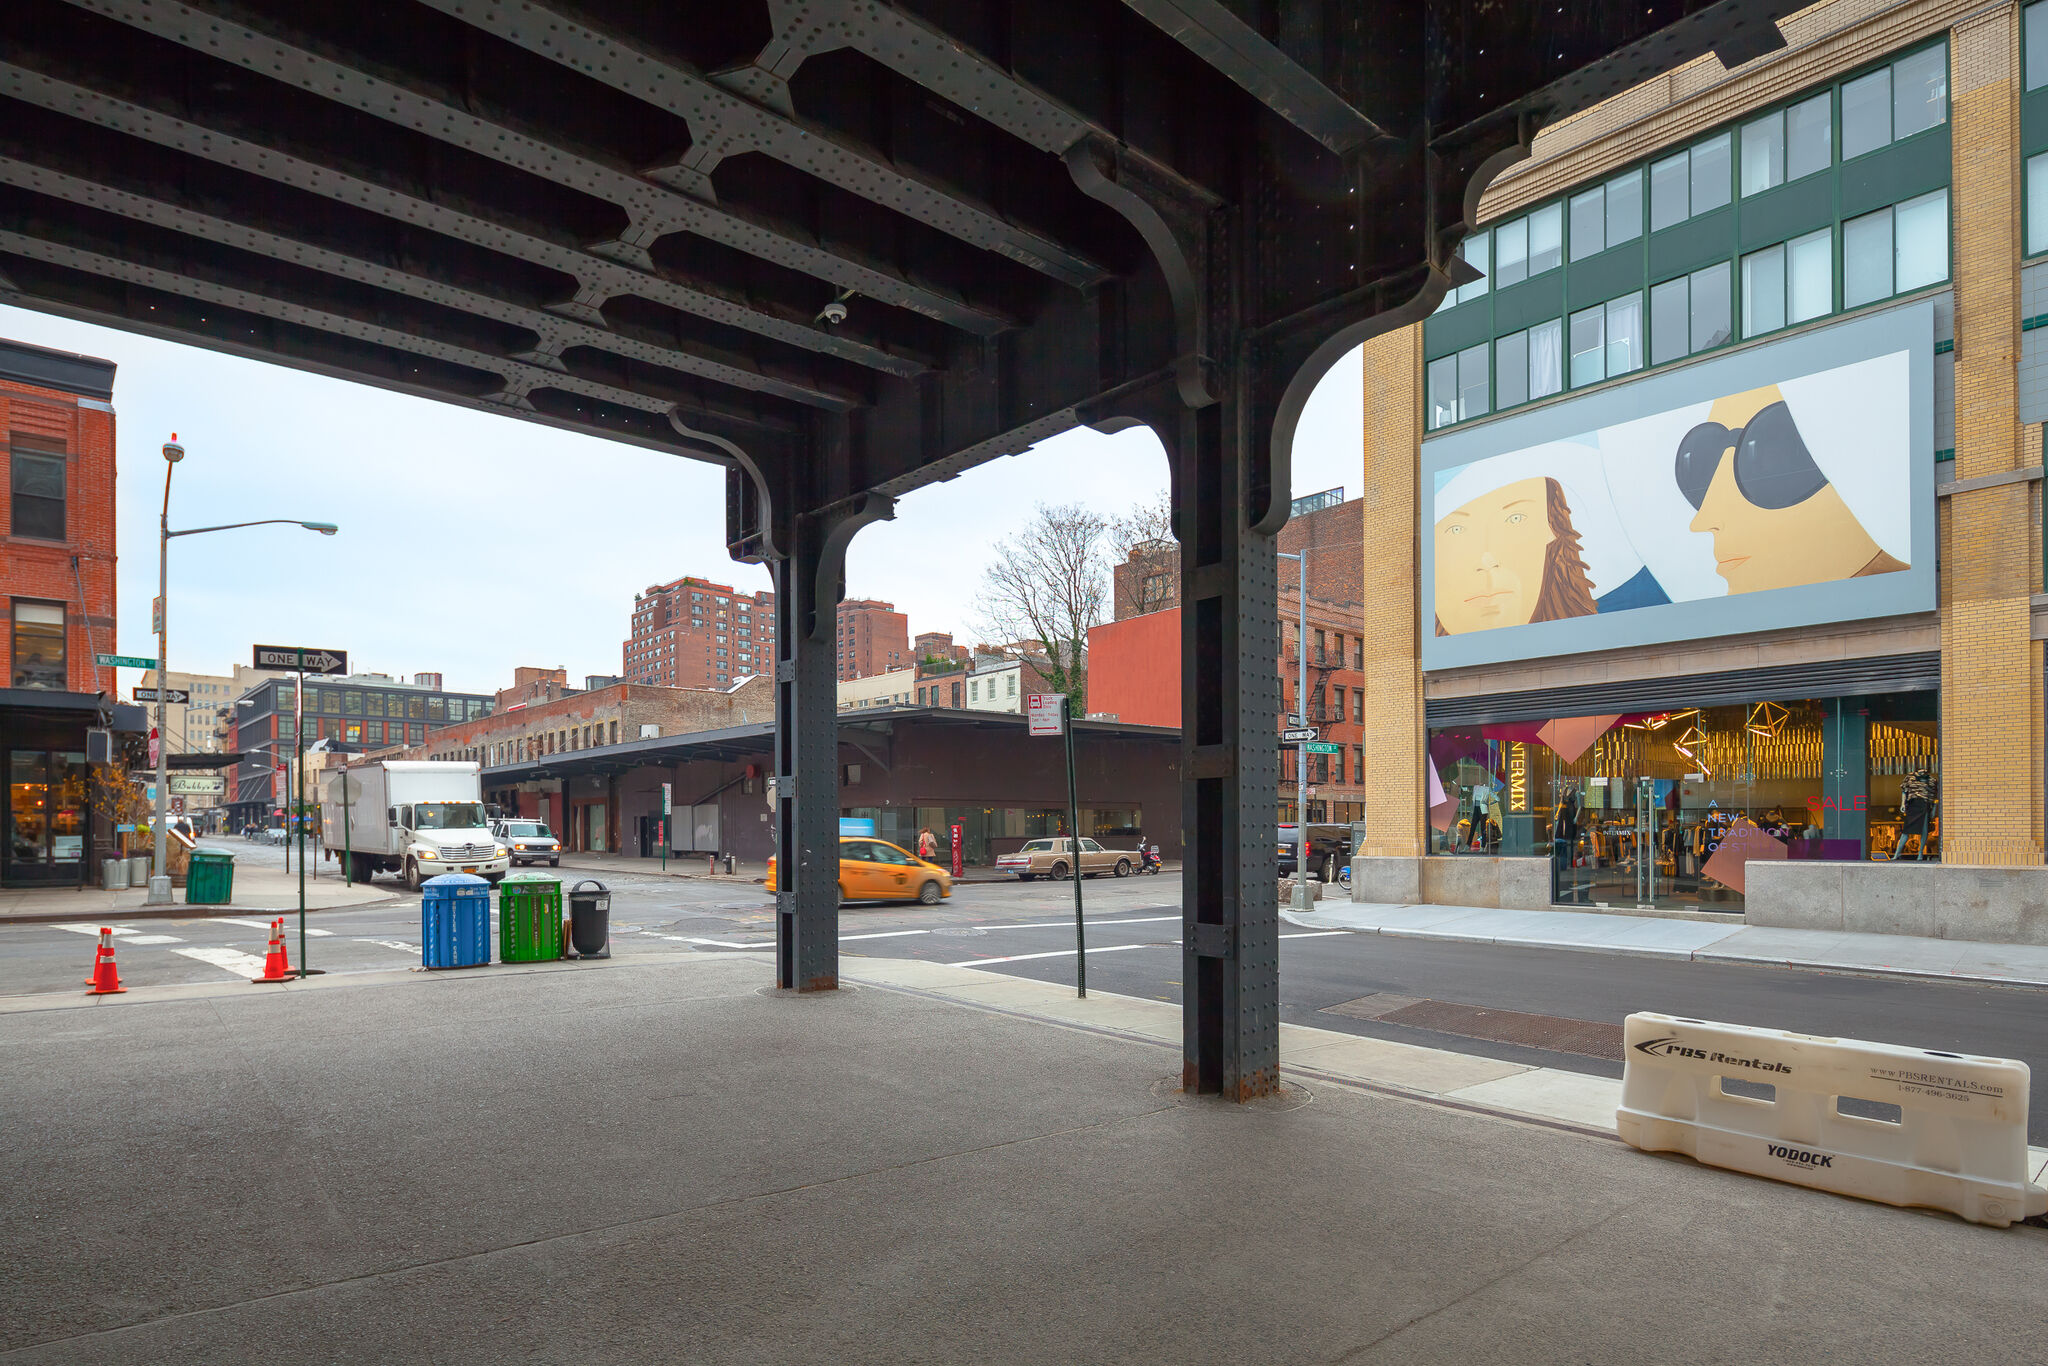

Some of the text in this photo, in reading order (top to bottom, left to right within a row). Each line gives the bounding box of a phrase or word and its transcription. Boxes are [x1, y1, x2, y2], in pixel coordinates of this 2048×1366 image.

[99, 655, 146, 668] WASHINGTON
[267, 653, 333, 667] ONE WAY
[141, 691, 181, 701] ONE WAY
[1307, 744, 1332, 752] WASHINGTON
[1511, 740, 1525, 811] NTERMIX
[173, 780, 210, 792] Bubby's
[1708, 799, 1718, 808] A
[1807, 795, 1868, 811] SALE
[1707, 813, 1739, 823] NEW
[1708, 827, 1789, 838] TRADITION
[1708, 842, 1728, 852] OF
[1666, 1045, 1793, 1074] PBS Rentals
[1898, 1084, 1970, 1102] 1-877-496-3625
[1767, 1144, 1833, 1168] YODOCK
